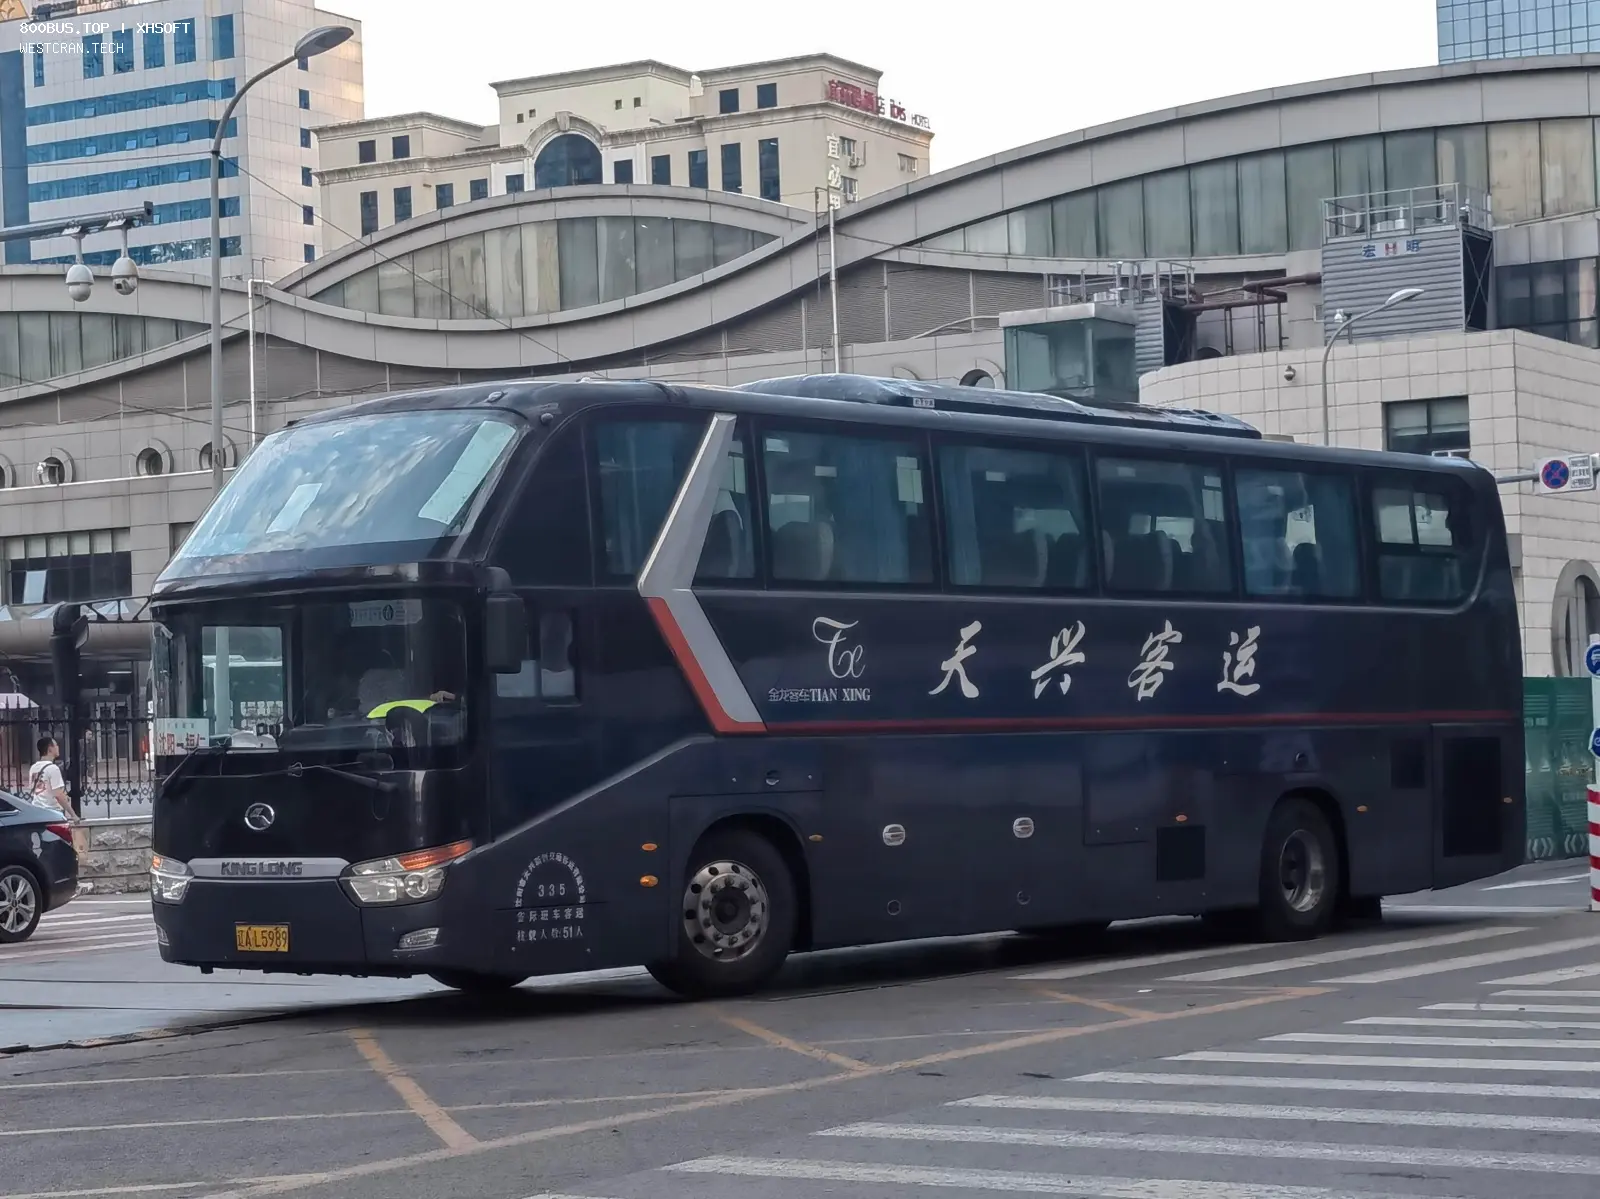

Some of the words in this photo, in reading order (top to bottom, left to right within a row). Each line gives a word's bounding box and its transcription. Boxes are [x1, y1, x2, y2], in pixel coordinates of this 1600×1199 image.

[809, 688, 838, 702] TIAN
[842, 688, 871, 702] XING
[221, 861, 257, 876] KING
[258, 861, 303, 876] LONG
[538, 883, 566, 898] 335
